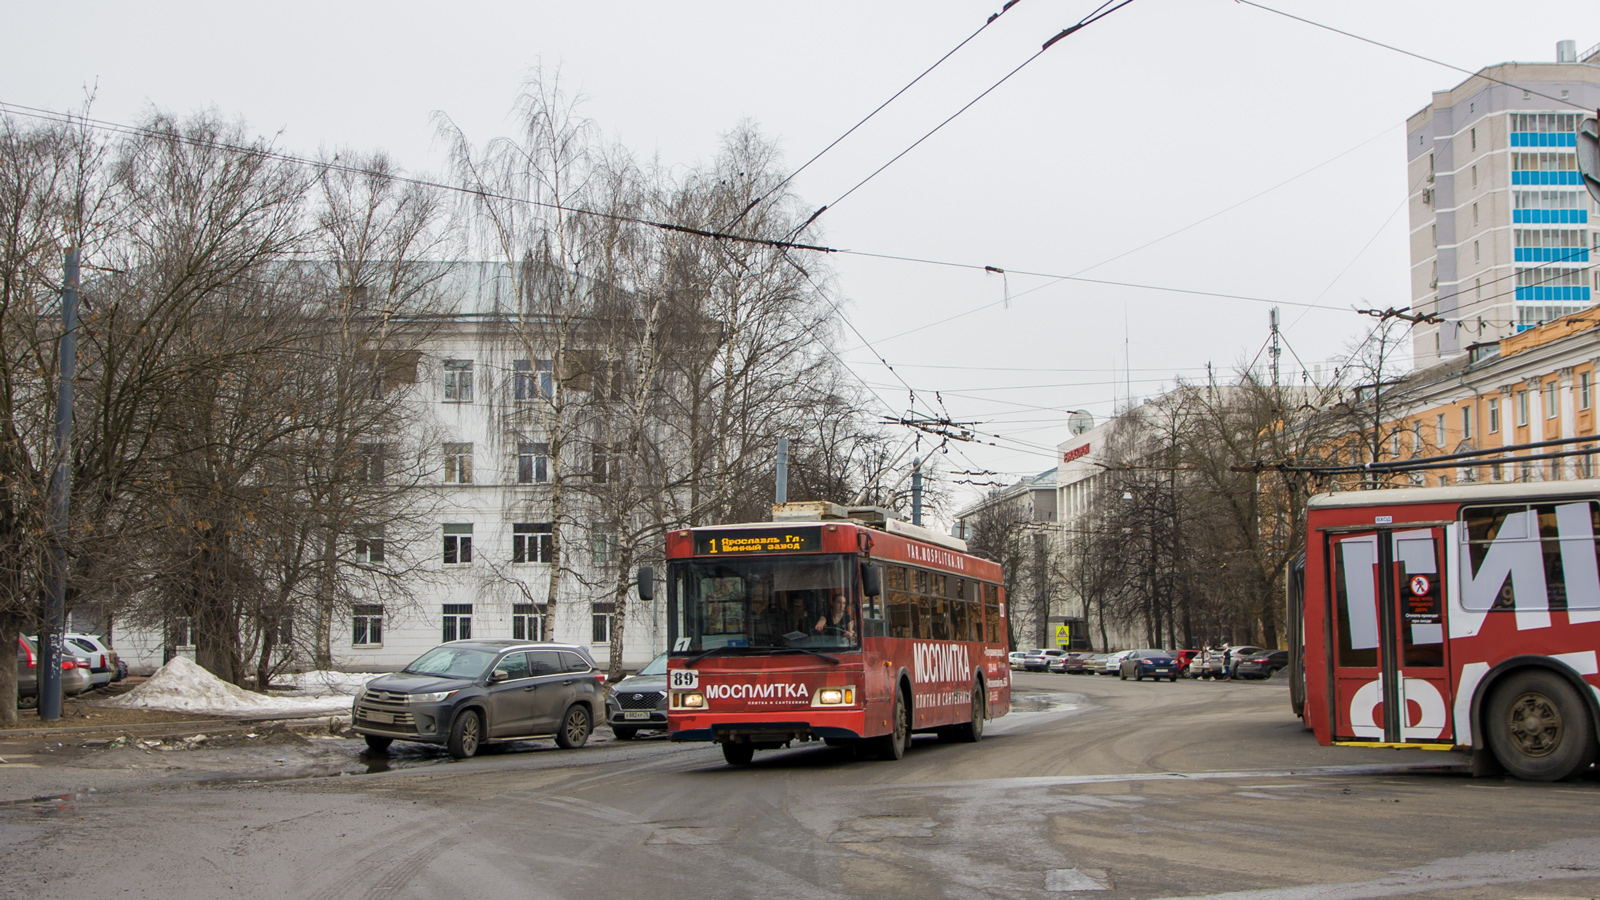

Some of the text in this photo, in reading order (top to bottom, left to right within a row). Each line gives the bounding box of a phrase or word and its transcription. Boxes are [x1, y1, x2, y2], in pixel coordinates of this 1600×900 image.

[709, 538, 718, 554] 1
[767, 542, 800, 550] завод
[785, 534, 805, 543] Гл.
[906, 543, 963, 570] YAR.MOSPLITKA.RU
[678, 640, 686, 652] 1
[913, 642, 971, 683] МОСПЛИТКА
[674, 672, 694, 686] 89
[706, 683, 809, 698] МОСПЛИТКА
[915, 694, 936, 709] ПЛИТКА
[937, 693, 941, 707] И
[942, 690, 972, 706] САНТЕХНИКА
